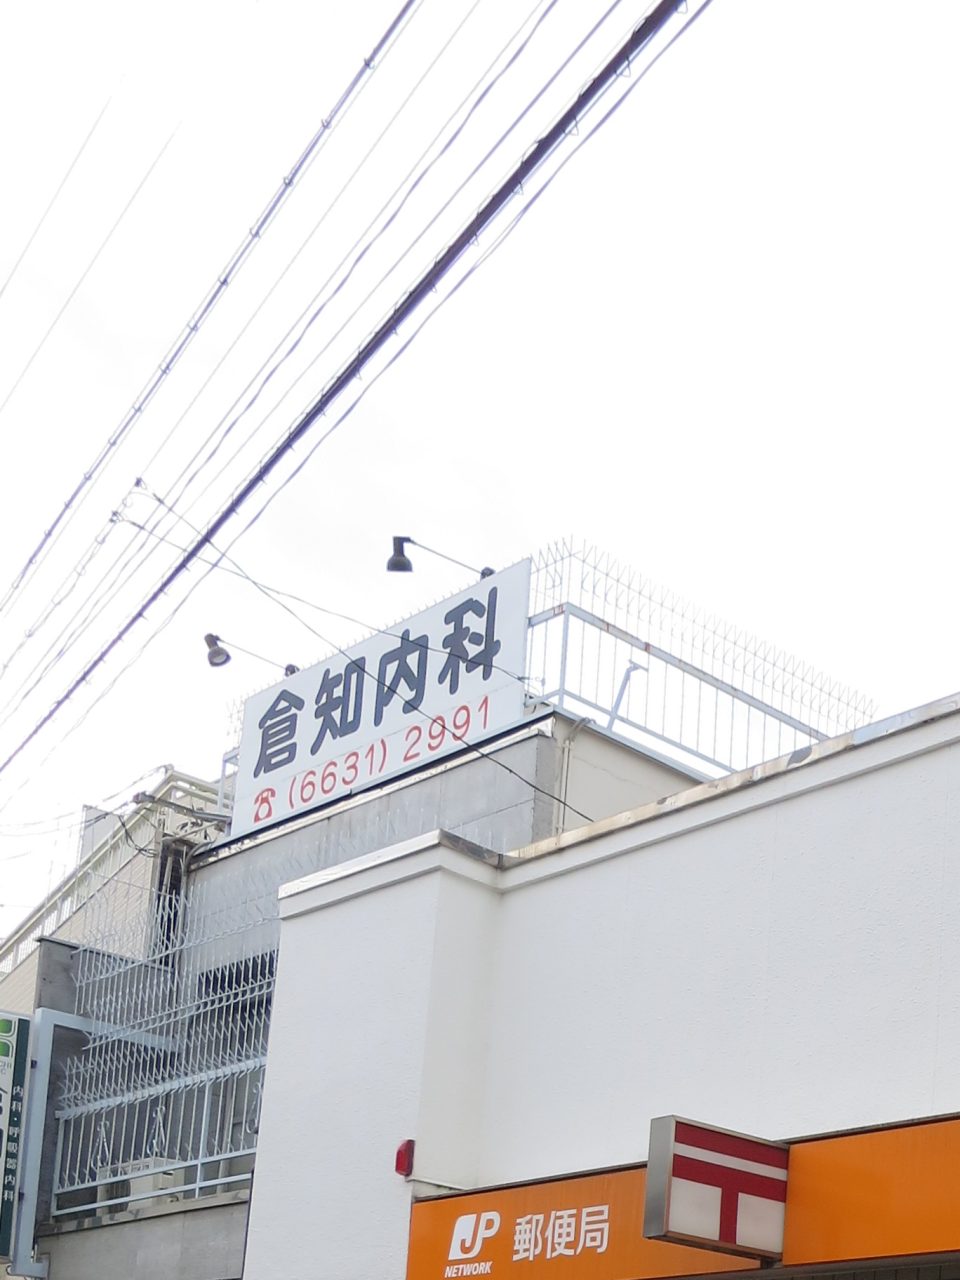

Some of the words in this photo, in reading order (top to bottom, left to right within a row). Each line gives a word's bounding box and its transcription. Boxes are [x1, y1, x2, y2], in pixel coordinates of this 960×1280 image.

[253, 587, 501, 778] 倉知内科
[288, 738, 387, 809] (6631)
[402, 695, 489, 763] 2991
[444, 1261, 492, 1278] NETWORK
[512, 1204, 609, 1261] 郵便局
